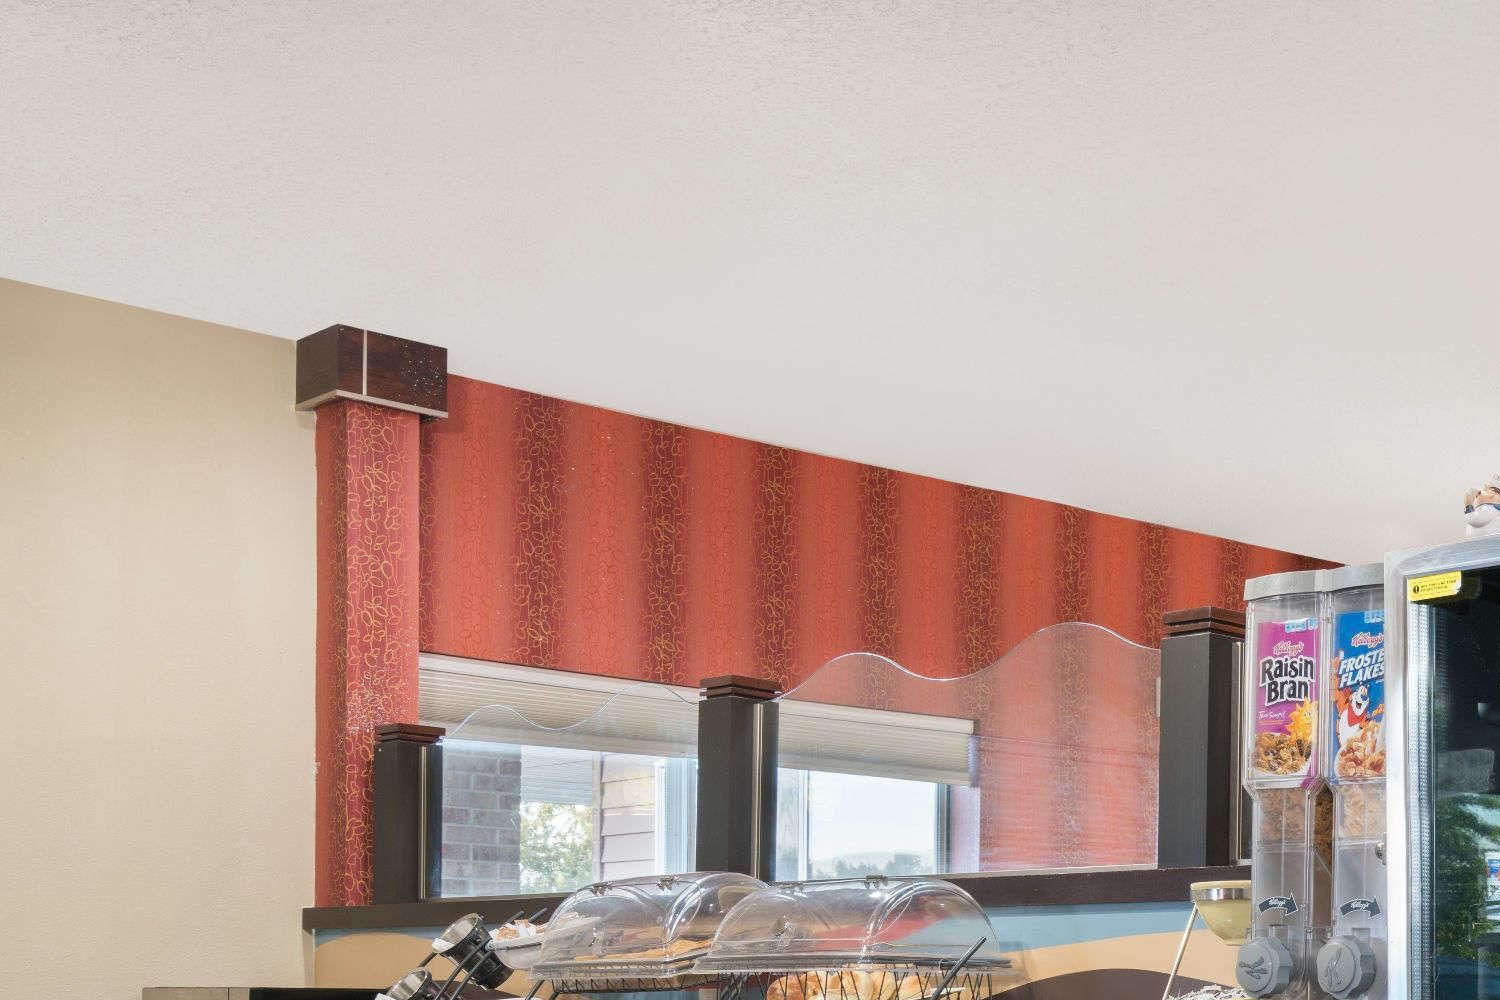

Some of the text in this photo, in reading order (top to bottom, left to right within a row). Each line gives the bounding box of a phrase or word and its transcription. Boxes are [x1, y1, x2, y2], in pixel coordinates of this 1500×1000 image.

[1260, 656, 1315, 686] Raisin
[1339, 648, 1384, 674] FROSTE
[1266, 680, 1310, 705] Bran
